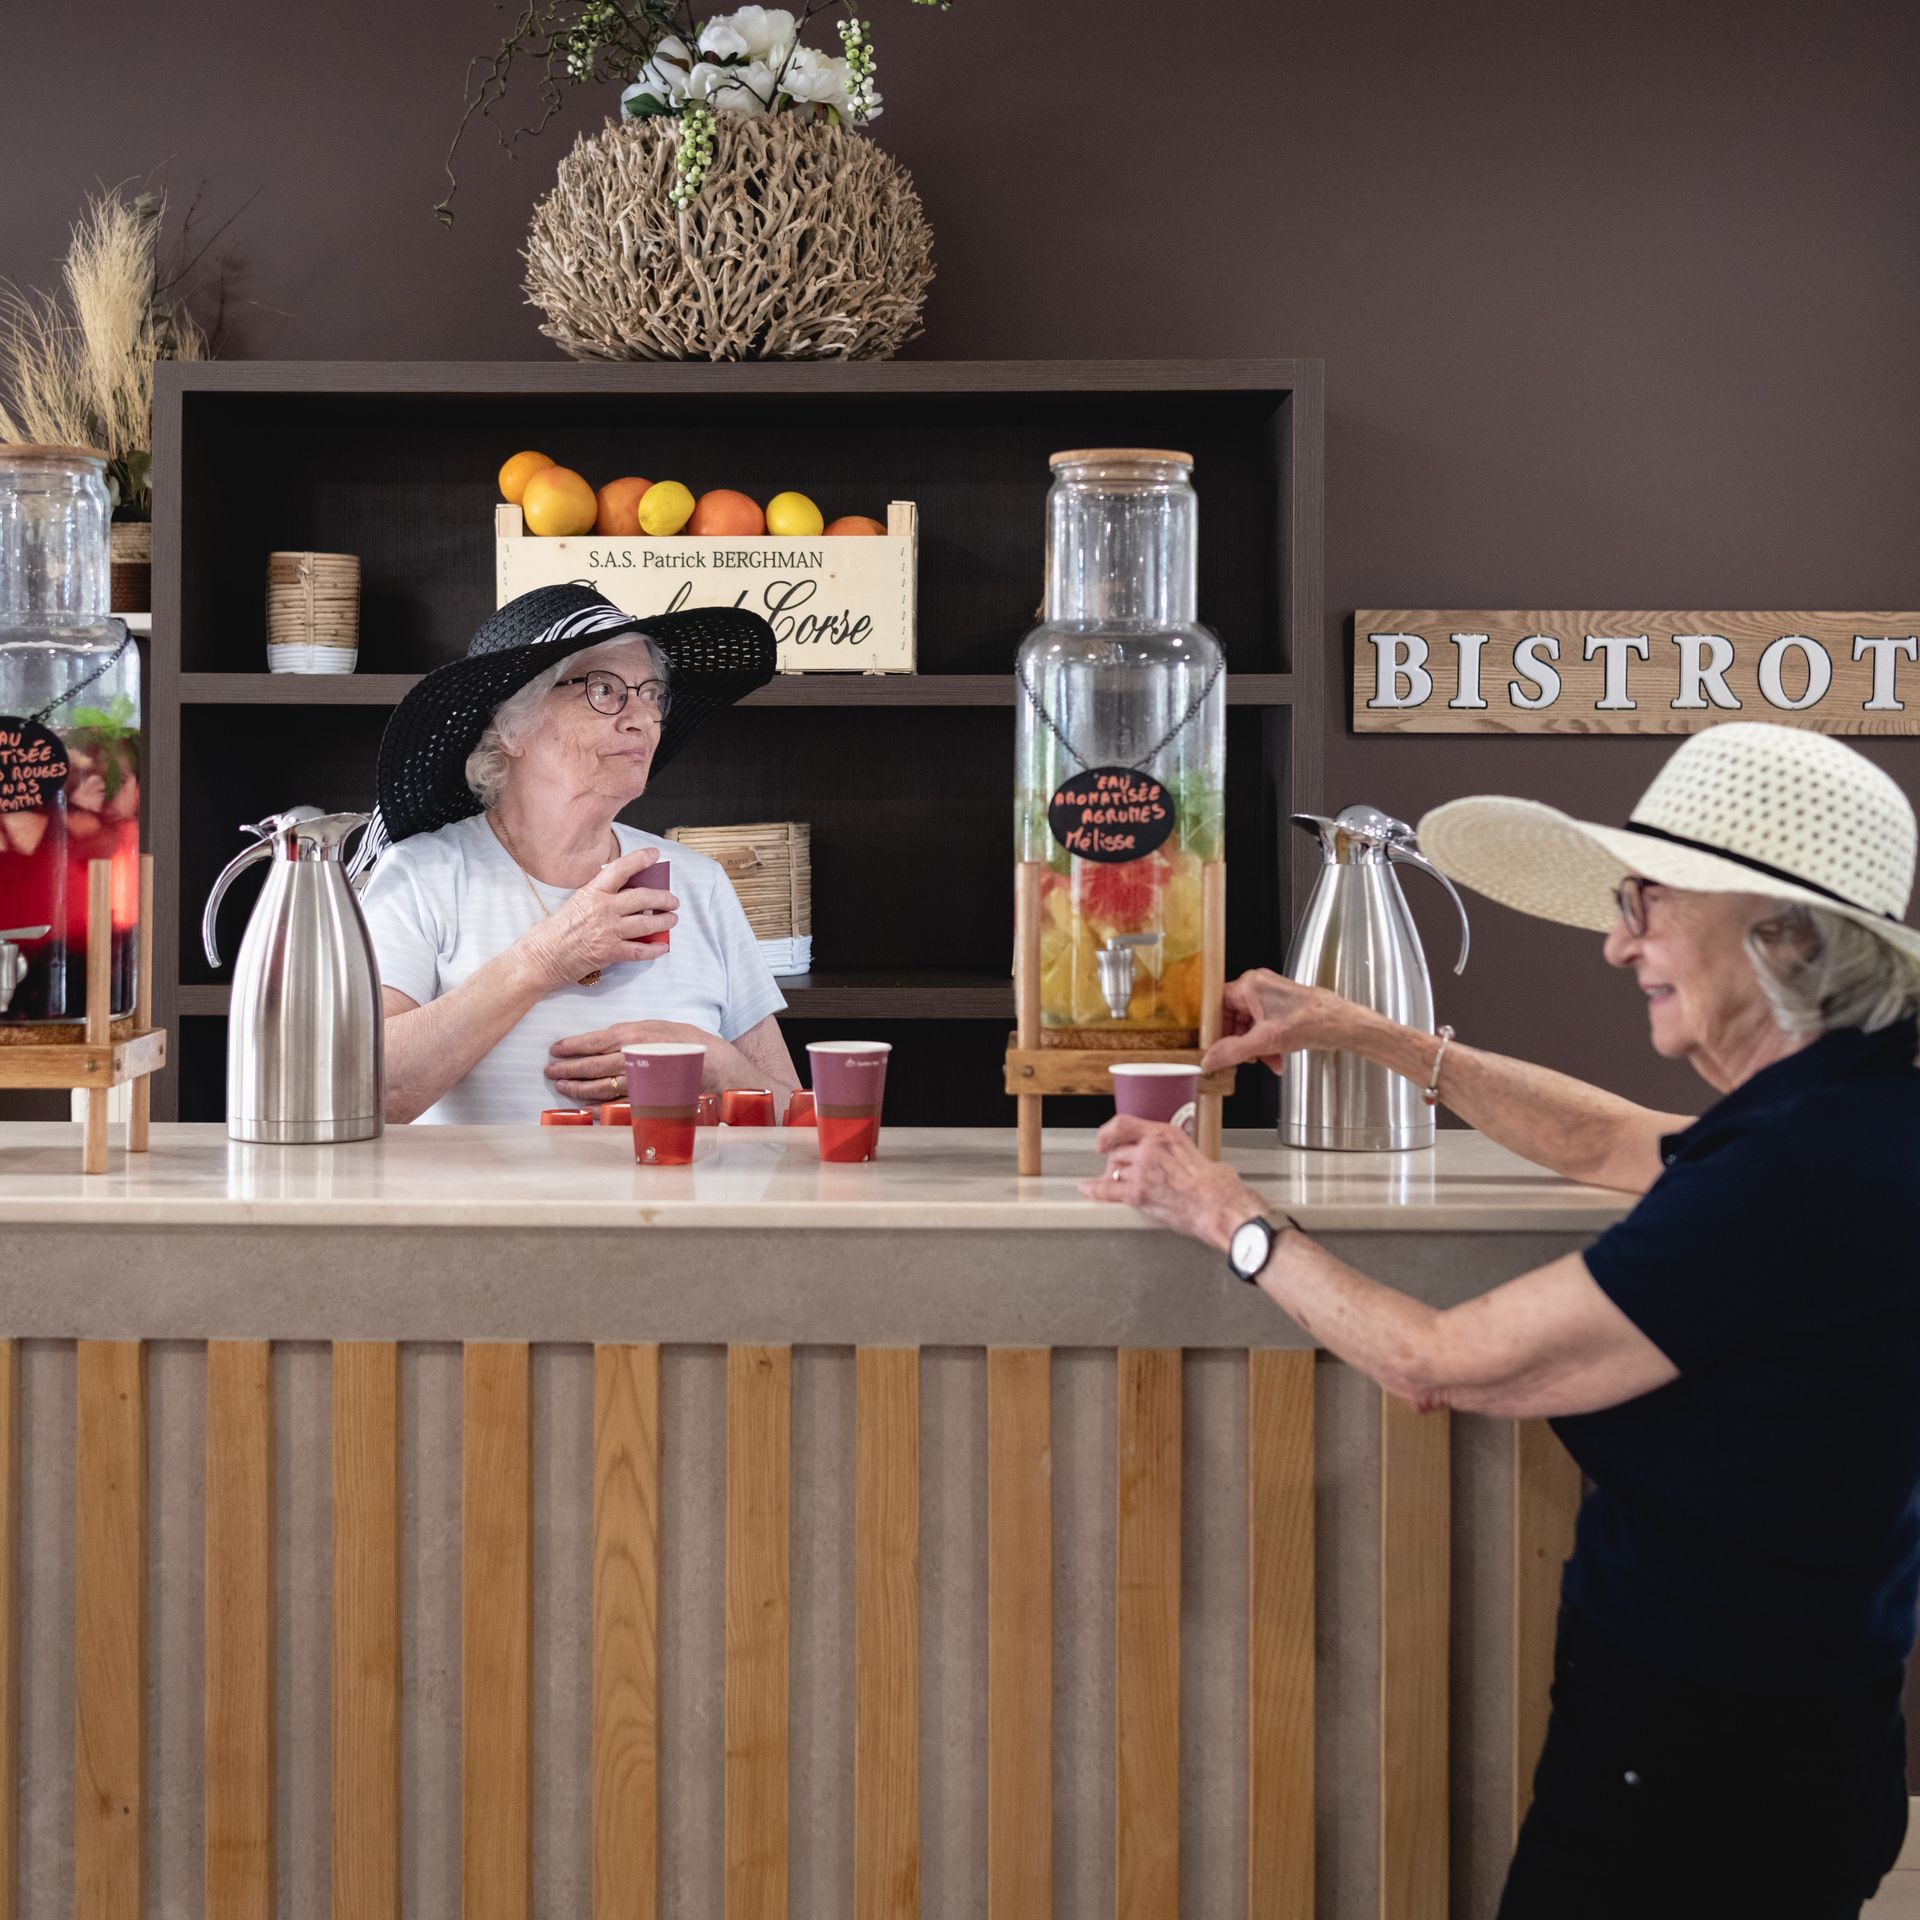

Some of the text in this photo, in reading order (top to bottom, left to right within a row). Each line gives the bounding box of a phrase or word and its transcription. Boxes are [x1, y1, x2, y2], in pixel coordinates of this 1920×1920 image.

[588, 550, 824, 568] S.A.S. Patrick BERGHMAN
[763, 579, 874, 645] Corse
[1367, 632, 1920, 711] BISTROT
[12, 762, 68, 781] ROUGES
[1096, 774, 1131, 791] EAU
[1081, 803, 1166, 824] AGRUMES
